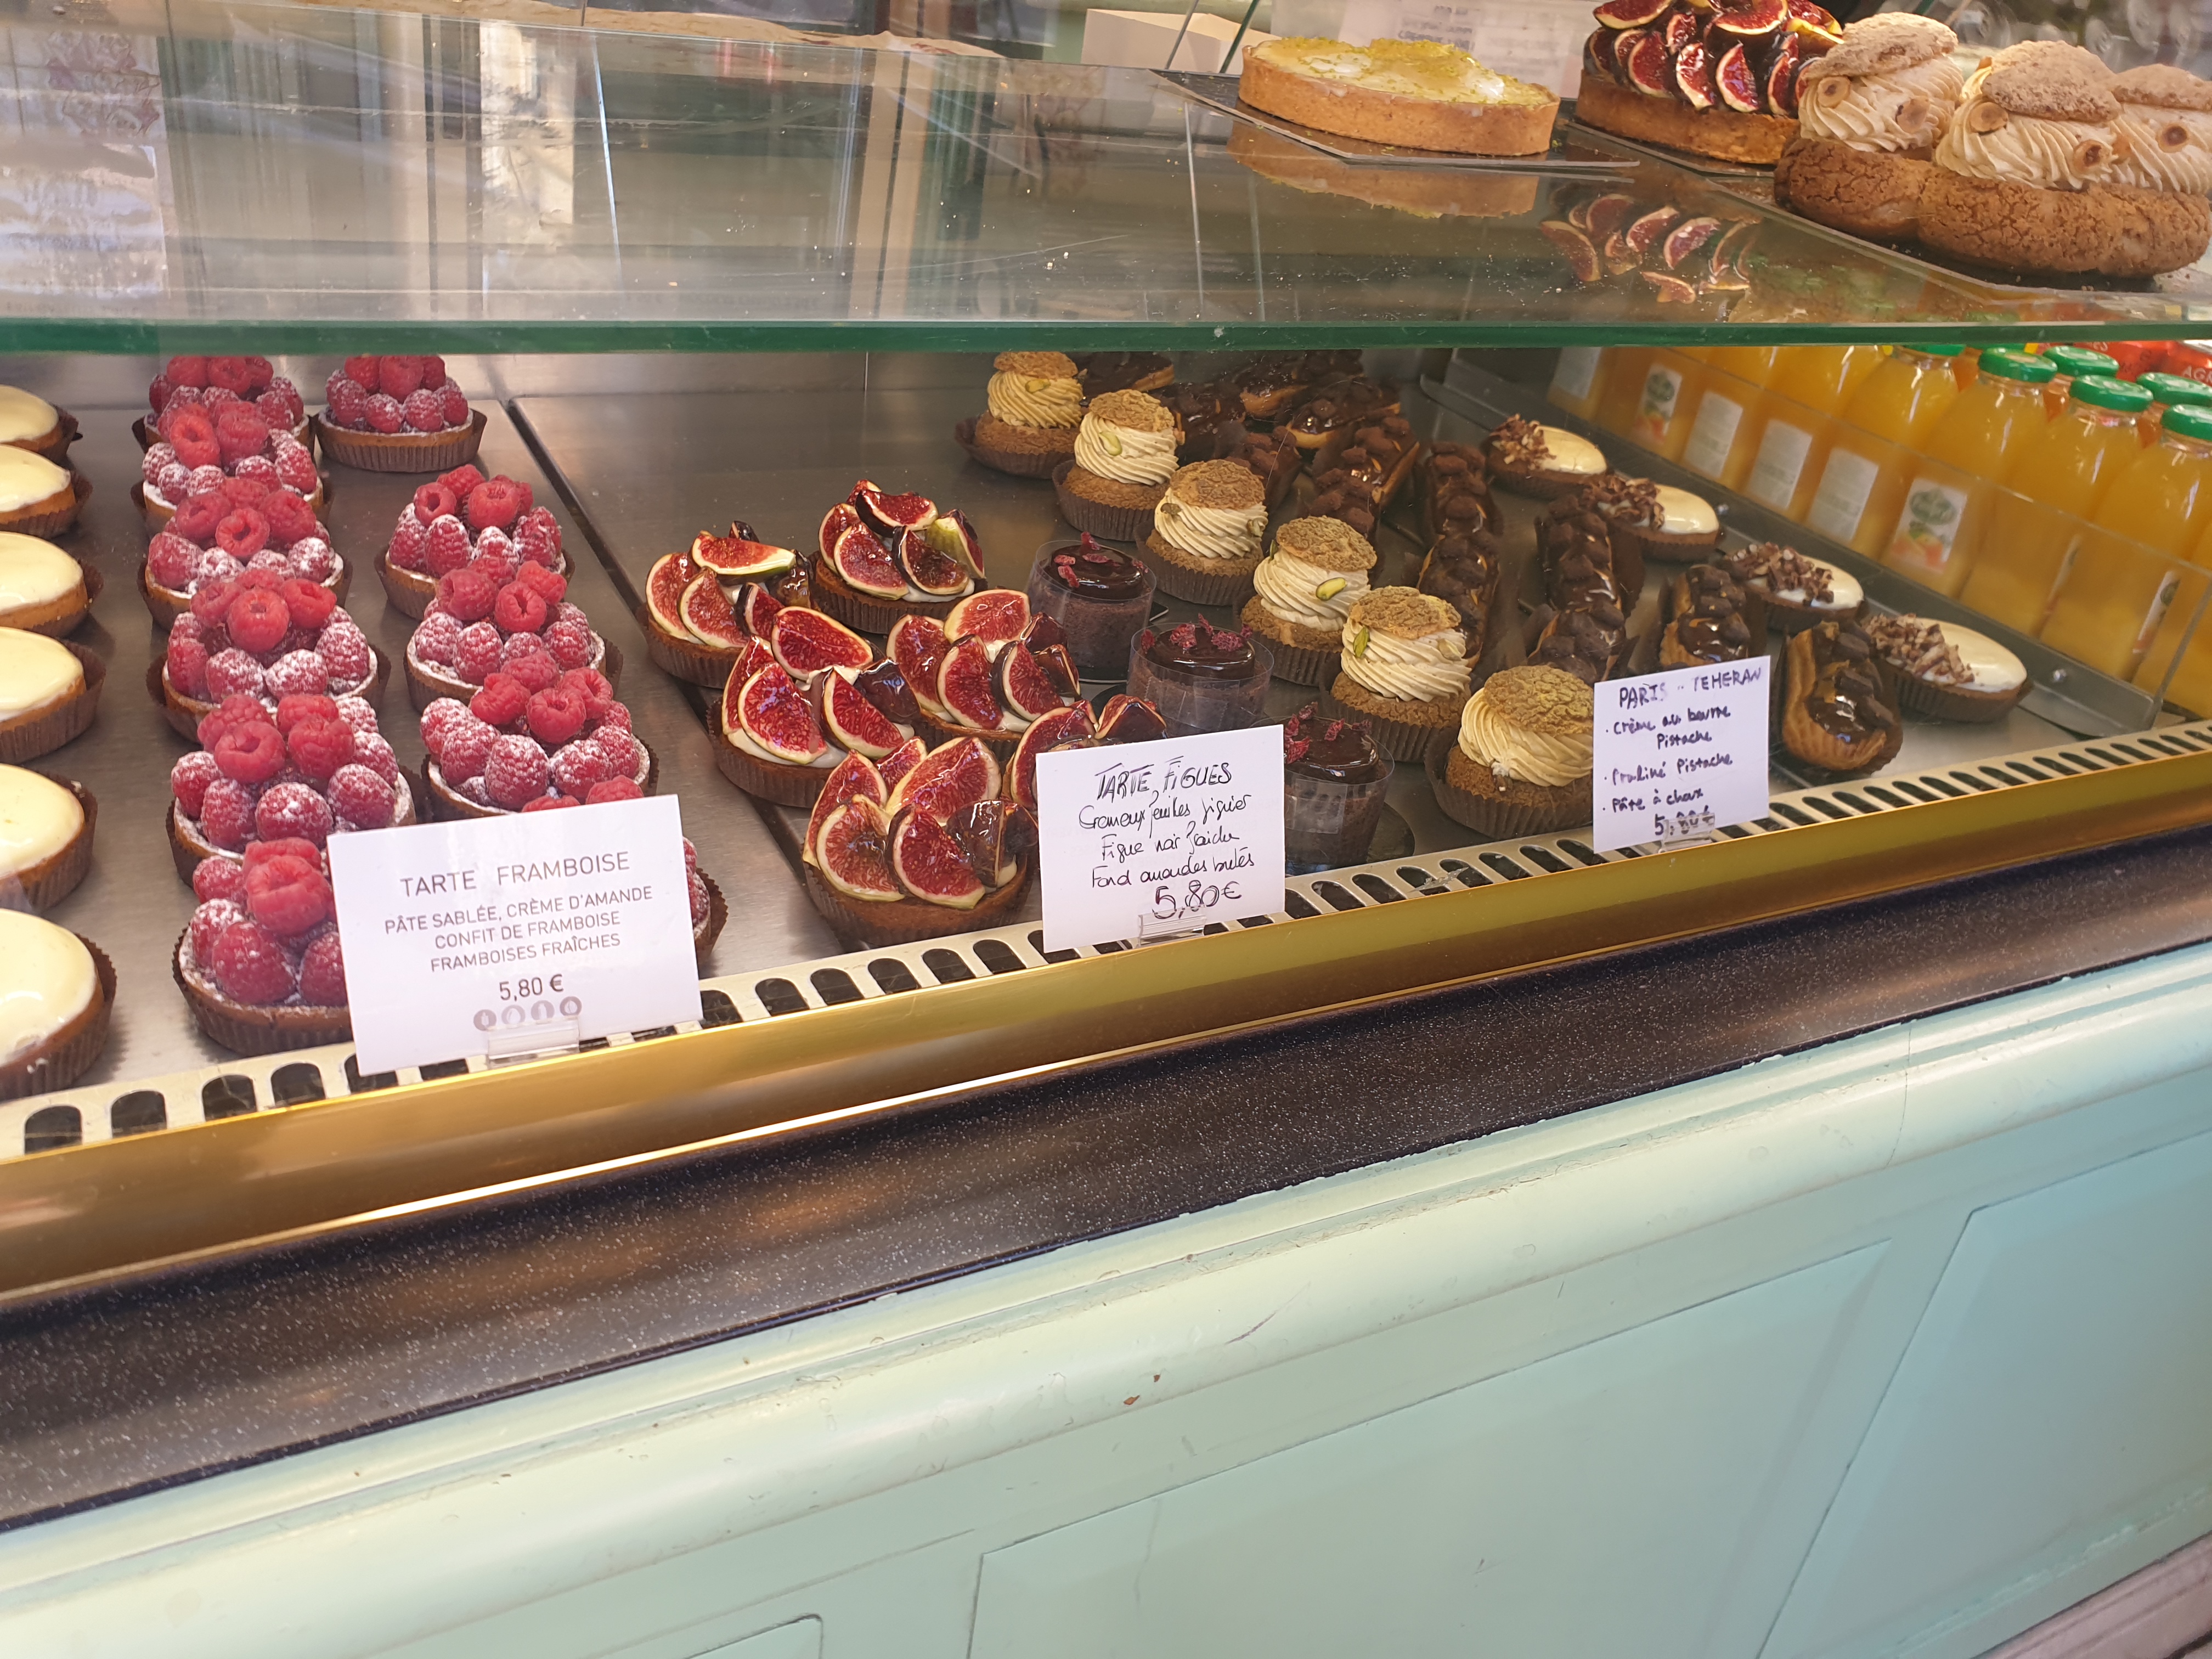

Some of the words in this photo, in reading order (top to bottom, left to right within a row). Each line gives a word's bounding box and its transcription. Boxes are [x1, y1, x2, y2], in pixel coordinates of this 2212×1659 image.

[1662, 714, 1681, 726] au
[1688, 706, 1731, 722] beurre
[1657, 730, 1712, 749] Pistache
[1677, 753, 1733, 774] Pistache
[1094, 763, 1154, 803] TARTE
[1653, 788, 1661, 805] à
[1102, 833, 1144, 864] Figue
[400, 870, 477, 898] TARTE
[497, 851, 630, 886] FRAMBOISE
[1092, 865, 1132, 888] Fond
[1140, 855, 1207, 883] amandes
[386, 912, 427, 934] PÂTE
[433, 905, 502, 928] SABLÉE,
[507, 896, 563, 918] CRÈME
[570, 886, 653, 910] D'AMANDE
[435, 927, 495, 950] CONFIT
[502, 924, 523, 941] DE
[528, 911, 621, 936] FRAMBOISE
[431, 945, 537, 972] FRAMBOISES
[542, 933, 621, 955] FRAÎCHES
[499, 977, 543, 1002] 5,80
